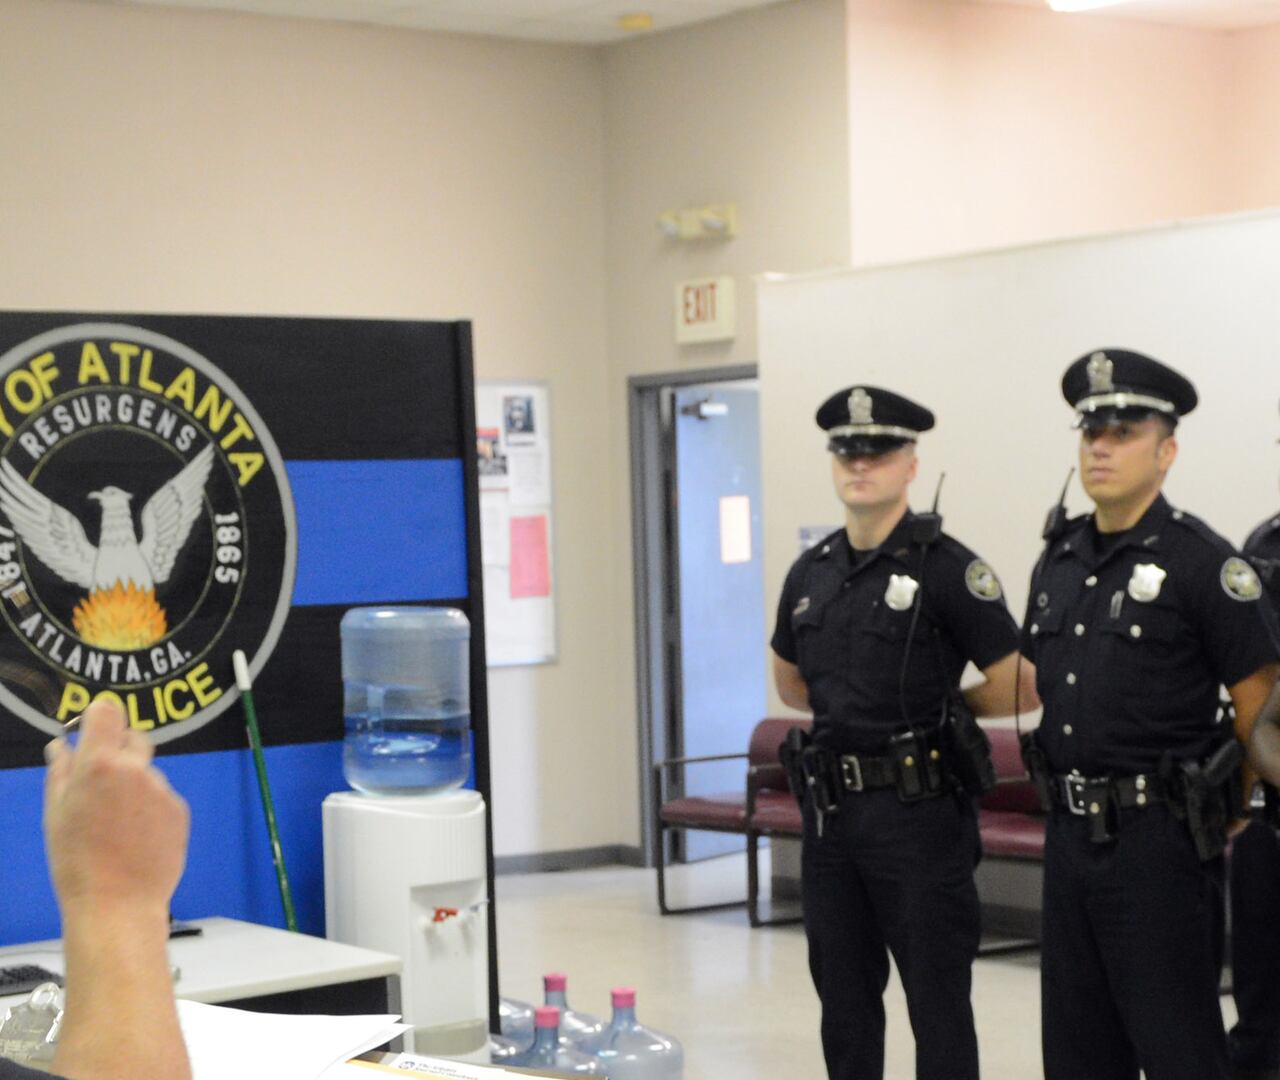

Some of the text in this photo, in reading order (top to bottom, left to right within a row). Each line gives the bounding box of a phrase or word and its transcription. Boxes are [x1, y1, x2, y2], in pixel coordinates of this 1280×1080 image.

[683, 283, 717, 325] EXIT
[5, 352, 60, 414] OF
[78, 342, 265, 487] ATLANTA
[19, 393, 198, 460] RESURGENS
[214, 511, 242, 584] 1865
